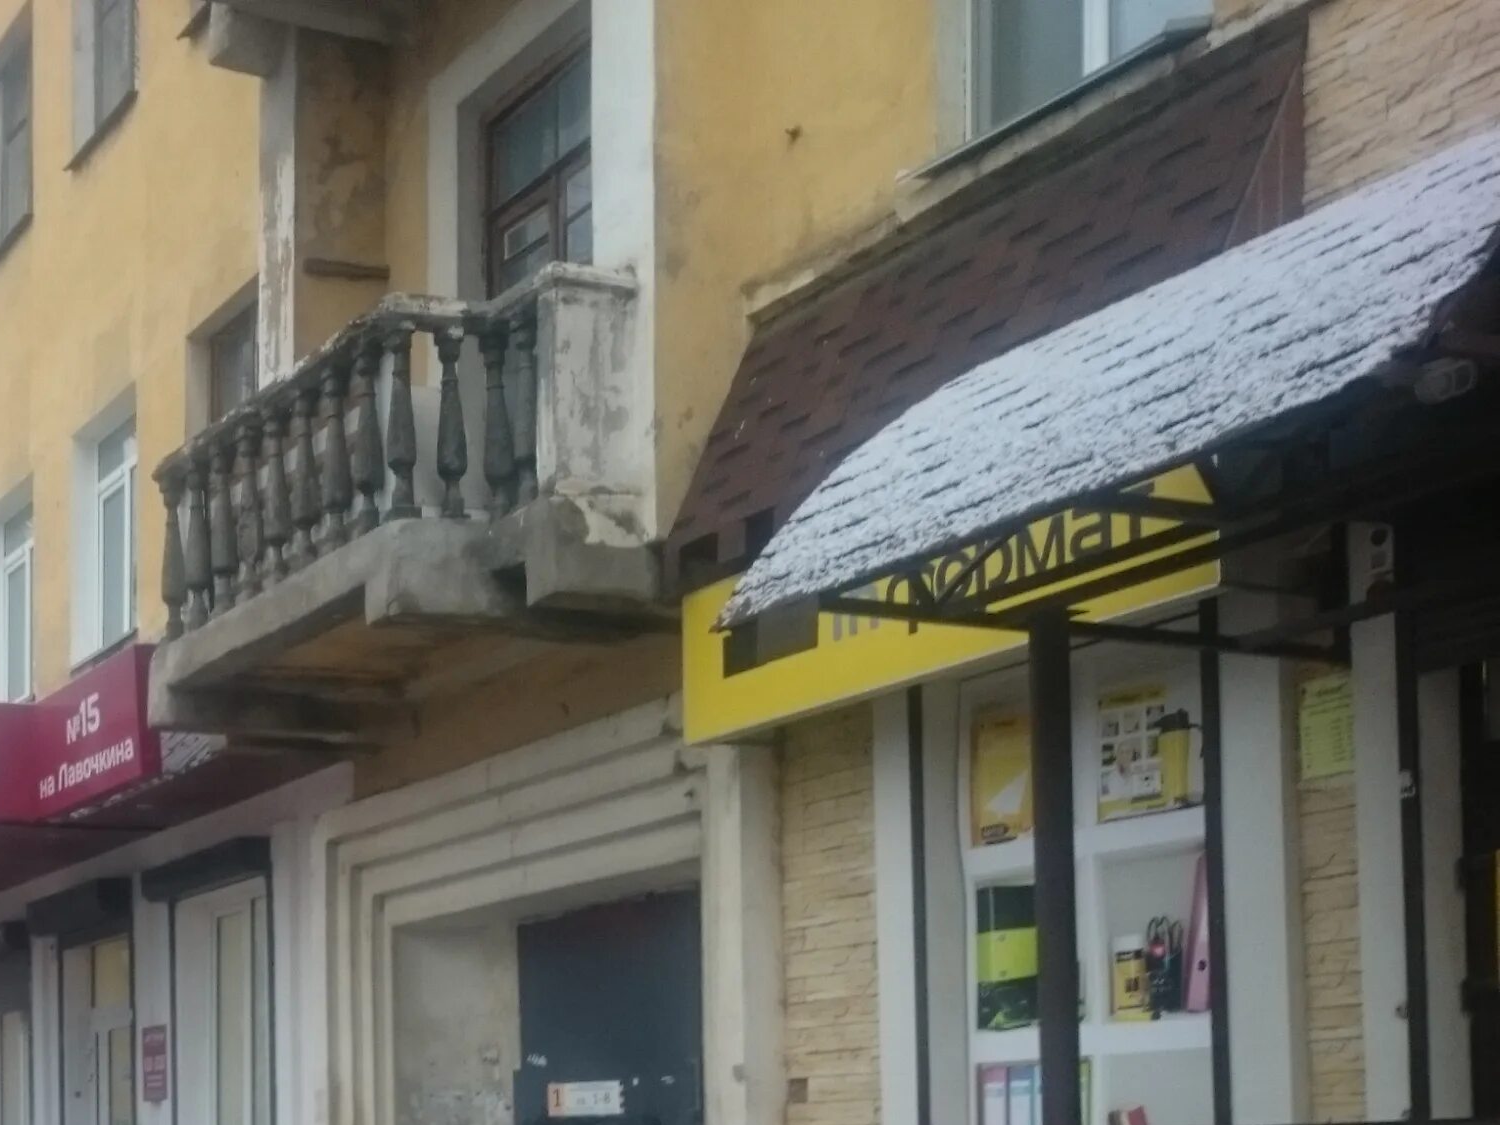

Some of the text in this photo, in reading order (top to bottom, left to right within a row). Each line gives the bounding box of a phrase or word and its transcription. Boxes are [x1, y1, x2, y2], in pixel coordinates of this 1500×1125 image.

[66, 692, 100, 745] №15
[40, 738, 134, 799] на Лавочкина
